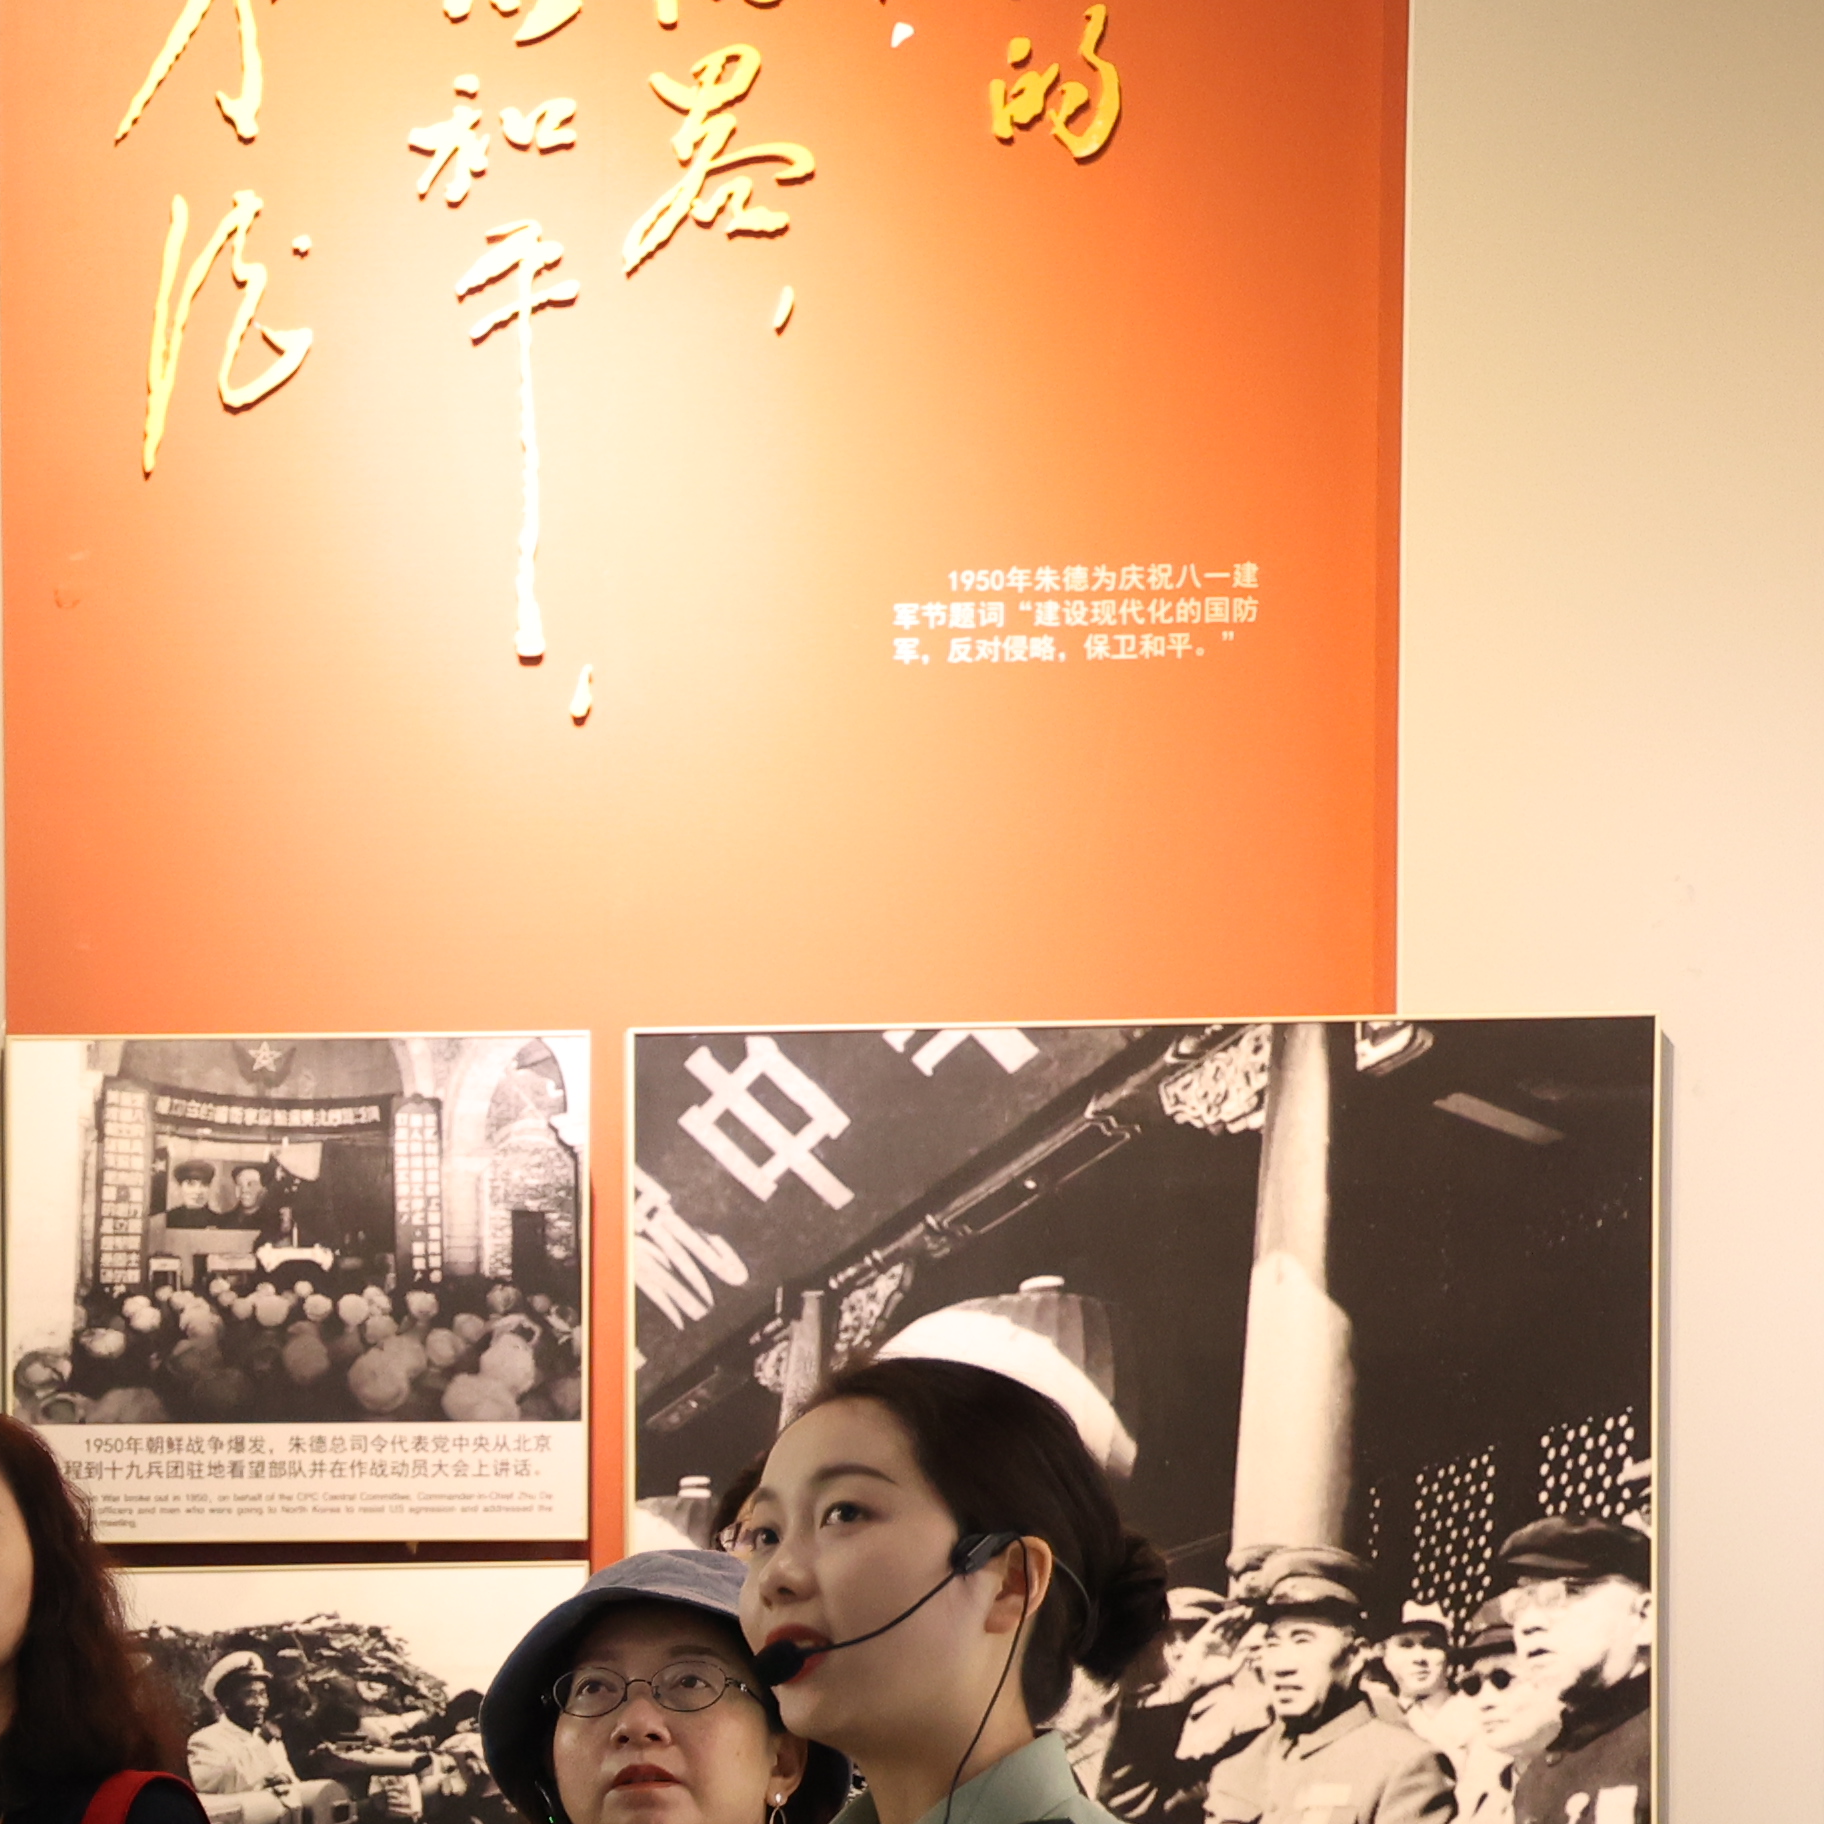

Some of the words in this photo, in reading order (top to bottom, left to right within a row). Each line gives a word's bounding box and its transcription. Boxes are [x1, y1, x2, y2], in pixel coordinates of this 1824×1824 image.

[948, 561, 1260, 594] 1950年朱德为庆祝八一建
